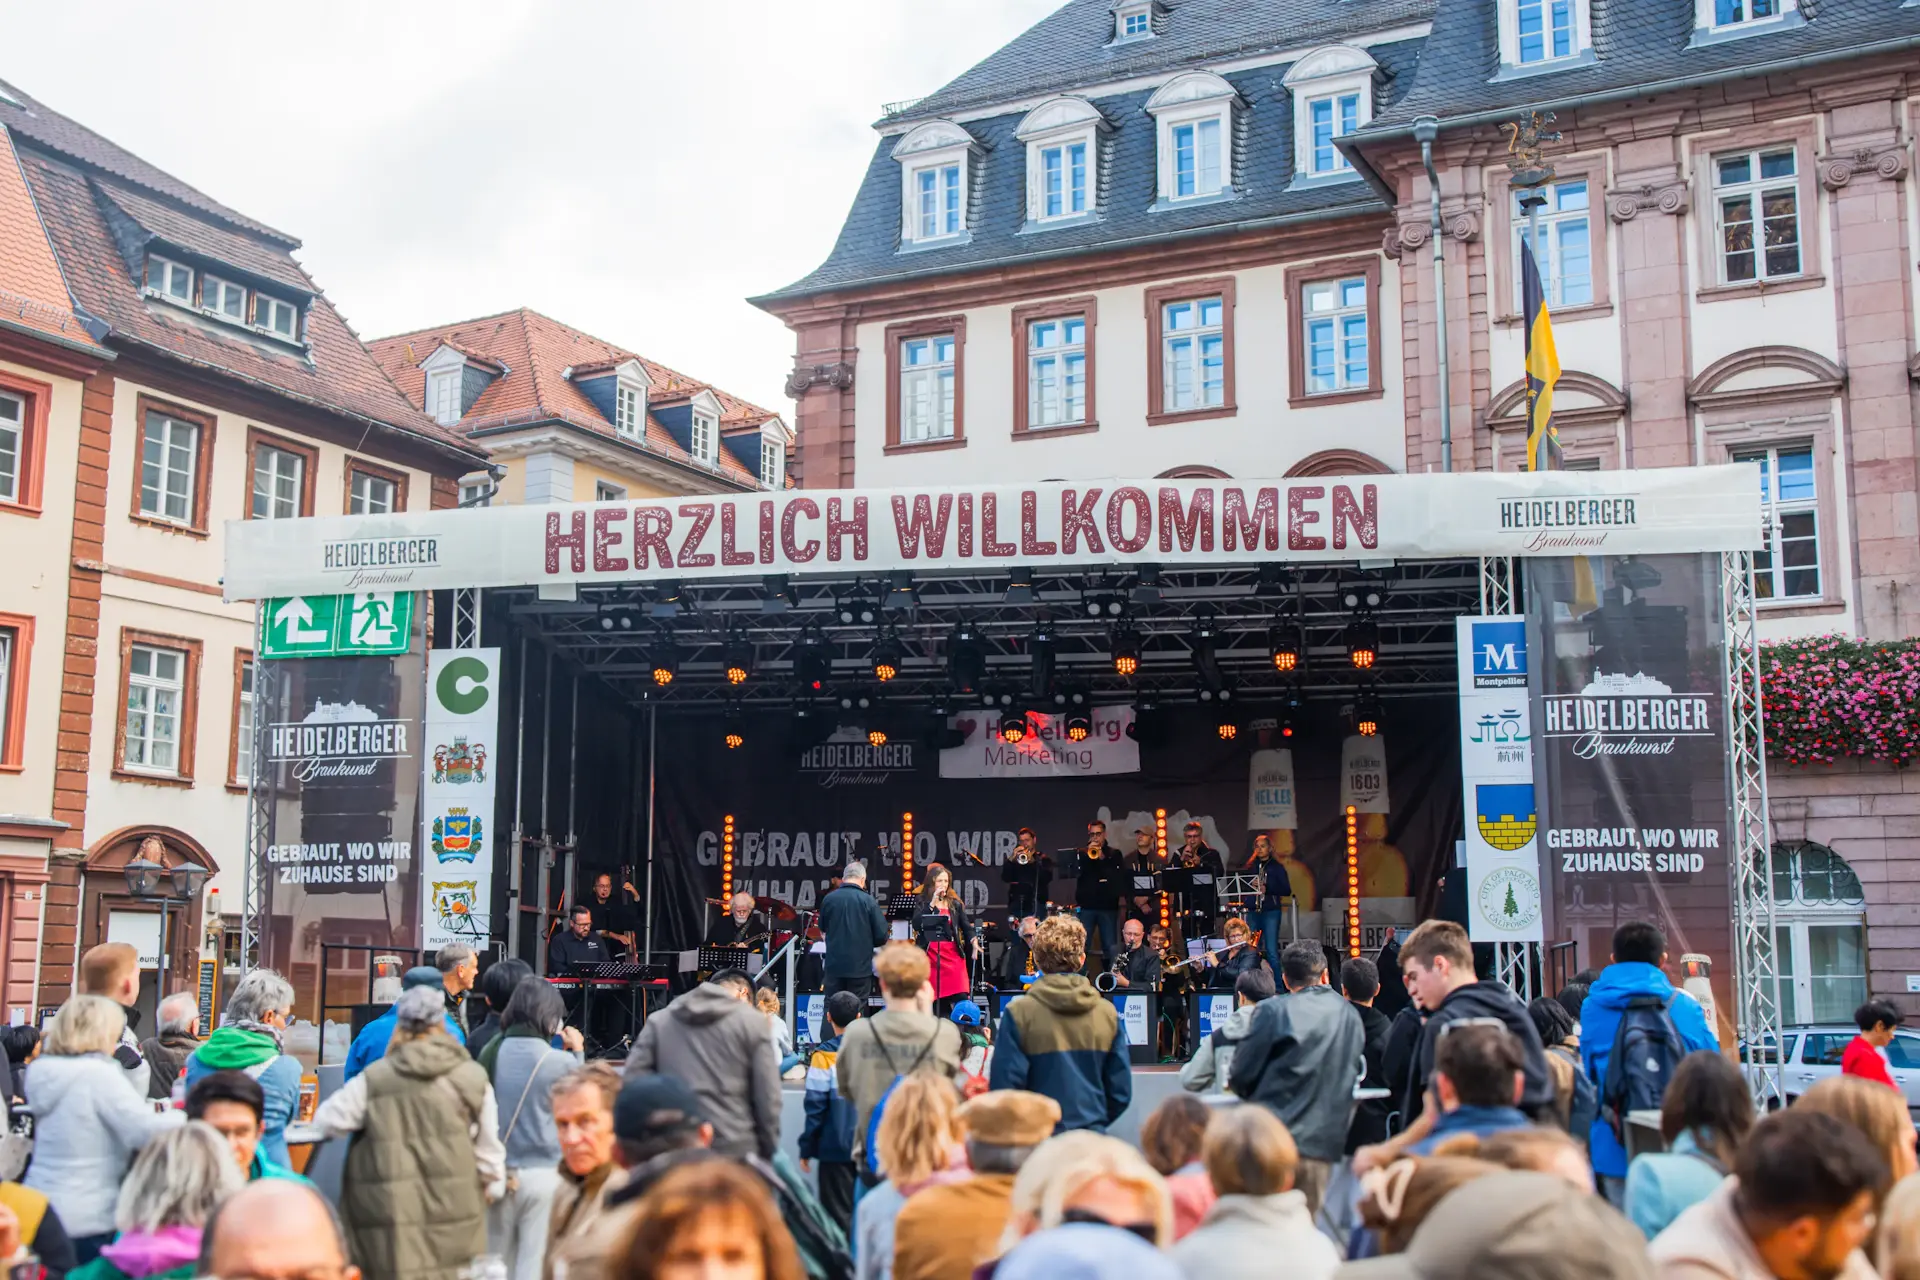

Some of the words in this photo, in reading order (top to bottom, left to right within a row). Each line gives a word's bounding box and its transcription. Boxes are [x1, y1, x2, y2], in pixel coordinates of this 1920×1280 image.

[1501, 498, 1636, 528] HEIDELBERGER
[545, 496, 869, 574] HERZLICH
[890, 484, 1378, 559] WILLKOMMEN
[1522, 530, 1608, 551] Braukunst
[325, 539, 437, 568] HEIDELBERGER
[345, 567, 414, 589] Braukunst
[1482, 643, 1517, 670] M
[1476, 677, 1526, 687] Montpellier
[1545, 699, 1709, 731] HEIDELBERGER
[272, 724, 407, 757] HEIDELBERGER
[1572, 730, 1675, 760] Braukunst
[801, 744, 913, 768] HEIDELBERGER
[985, 745, 1092, 769] Marketing
[1497, 751, 1524, 763] 杭州
[292, 755, 377, 782] Braukunst
[1351, 774, 1380, 790] 1603
[1546, 828, 1642, 850] GEBRAUT,
[1643, 829, 1675, 848] WO
[1680, 829, 1719, 848] WIR
[267, 843, 343, 864] GEBRAUT,
[347, 843, 374, 860] WO
[379, 842, 411, 860] WIR
[1562, 853, 1652, 873] ZUHAUSE
[1656, 853, 1704, 873] SIND
[280, 865, 353, 884] ZUHAUSE
[358, 865, 398, 882] SIND
[1200, 1011, 1210, 1020] Big
